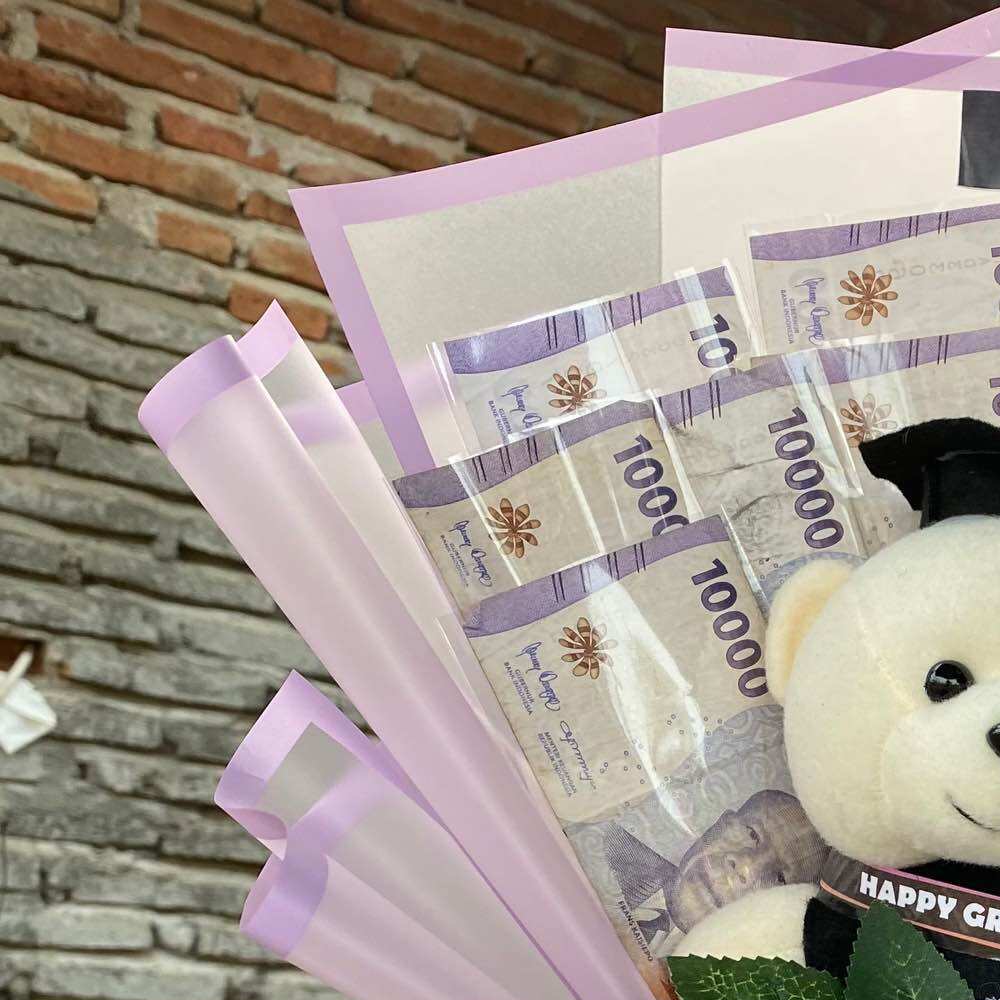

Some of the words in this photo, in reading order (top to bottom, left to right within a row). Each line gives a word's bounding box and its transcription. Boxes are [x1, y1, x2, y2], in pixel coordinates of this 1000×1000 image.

[768, 406, 845, 548] 10000
[691, 557, 769, 698] 10000
[859, 871, 957, 920] HAPPY
